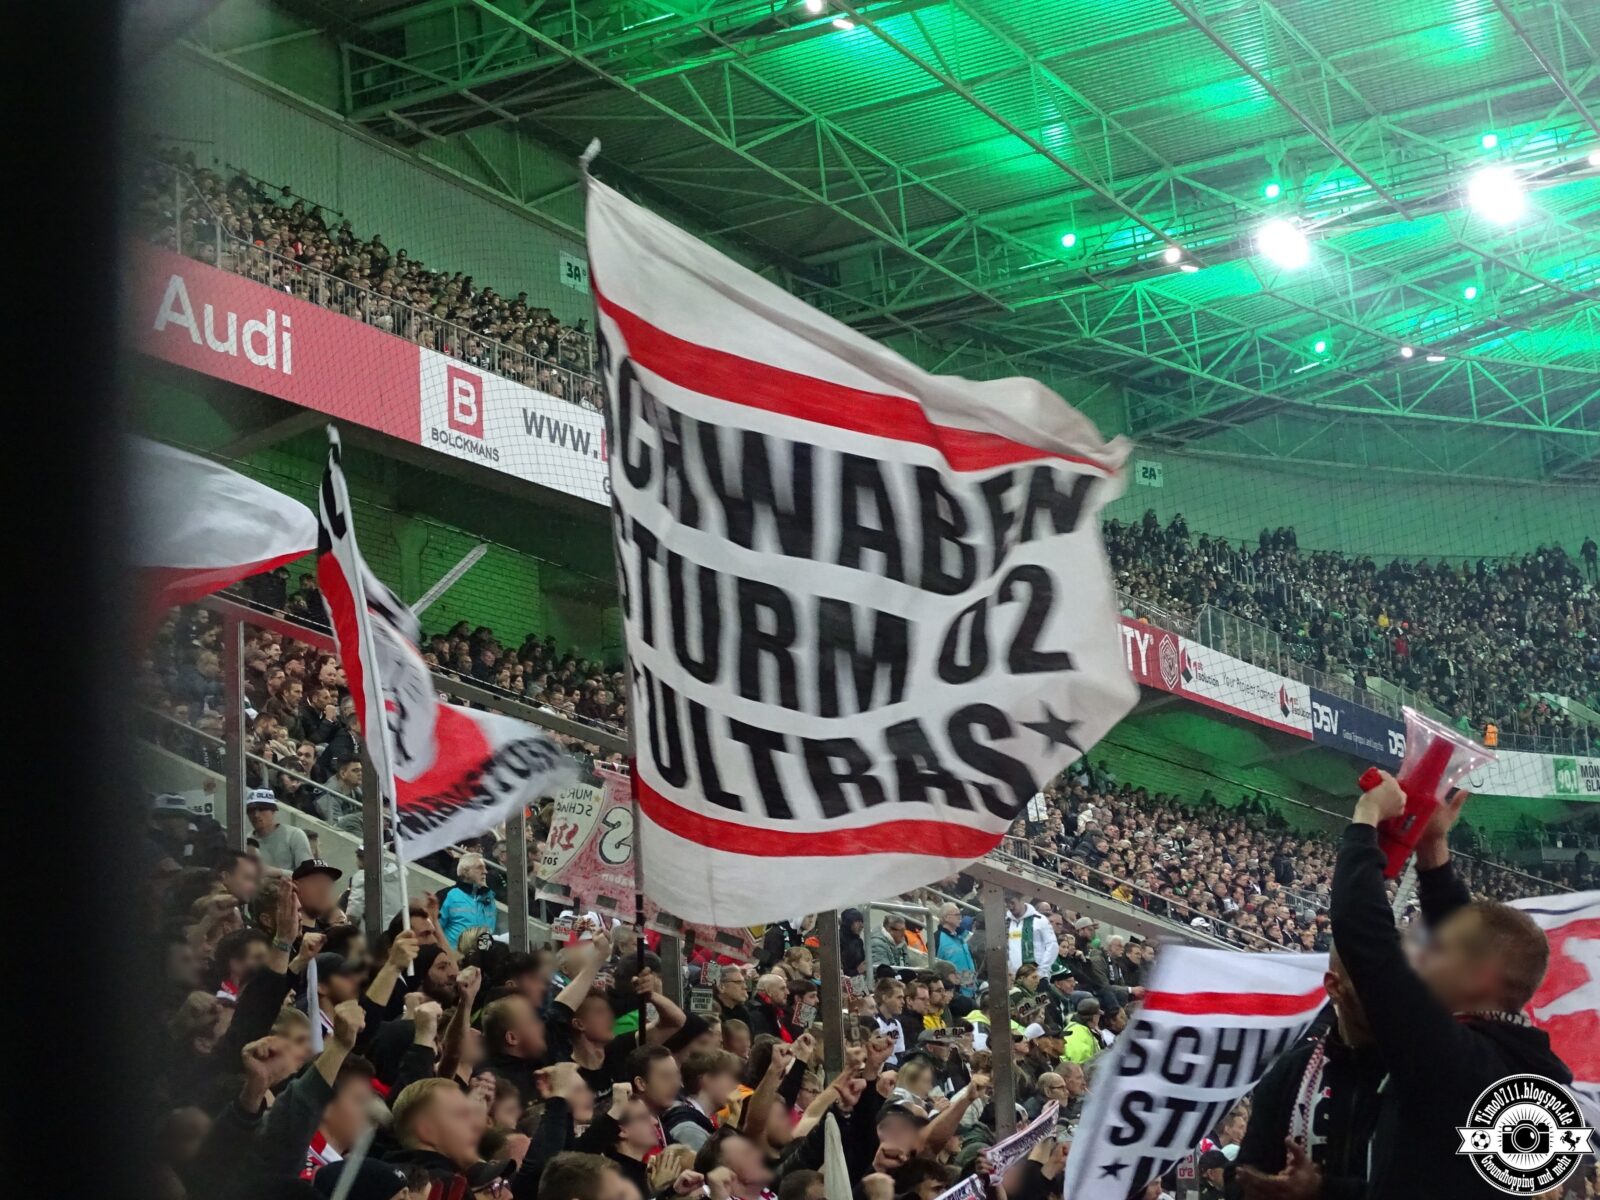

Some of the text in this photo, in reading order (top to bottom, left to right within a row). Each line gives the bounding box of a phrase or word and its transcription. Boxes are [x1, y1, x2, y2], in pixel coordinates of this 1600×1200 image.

[566, 261, 581, 282] 3A
[153, 273, 292, 375] Audi
[453, 376, 478, 426] B
[431, 427, 500, 462] BOLCKMANS
[1142, 466, 1157, 480] 2A
[937, 564, 1075, 684] 02
[1312, 701, 1339, 735] DSV
[643, 664, 1041, 820] ULTRAS
[1388, 729, 1406, 758] DS
